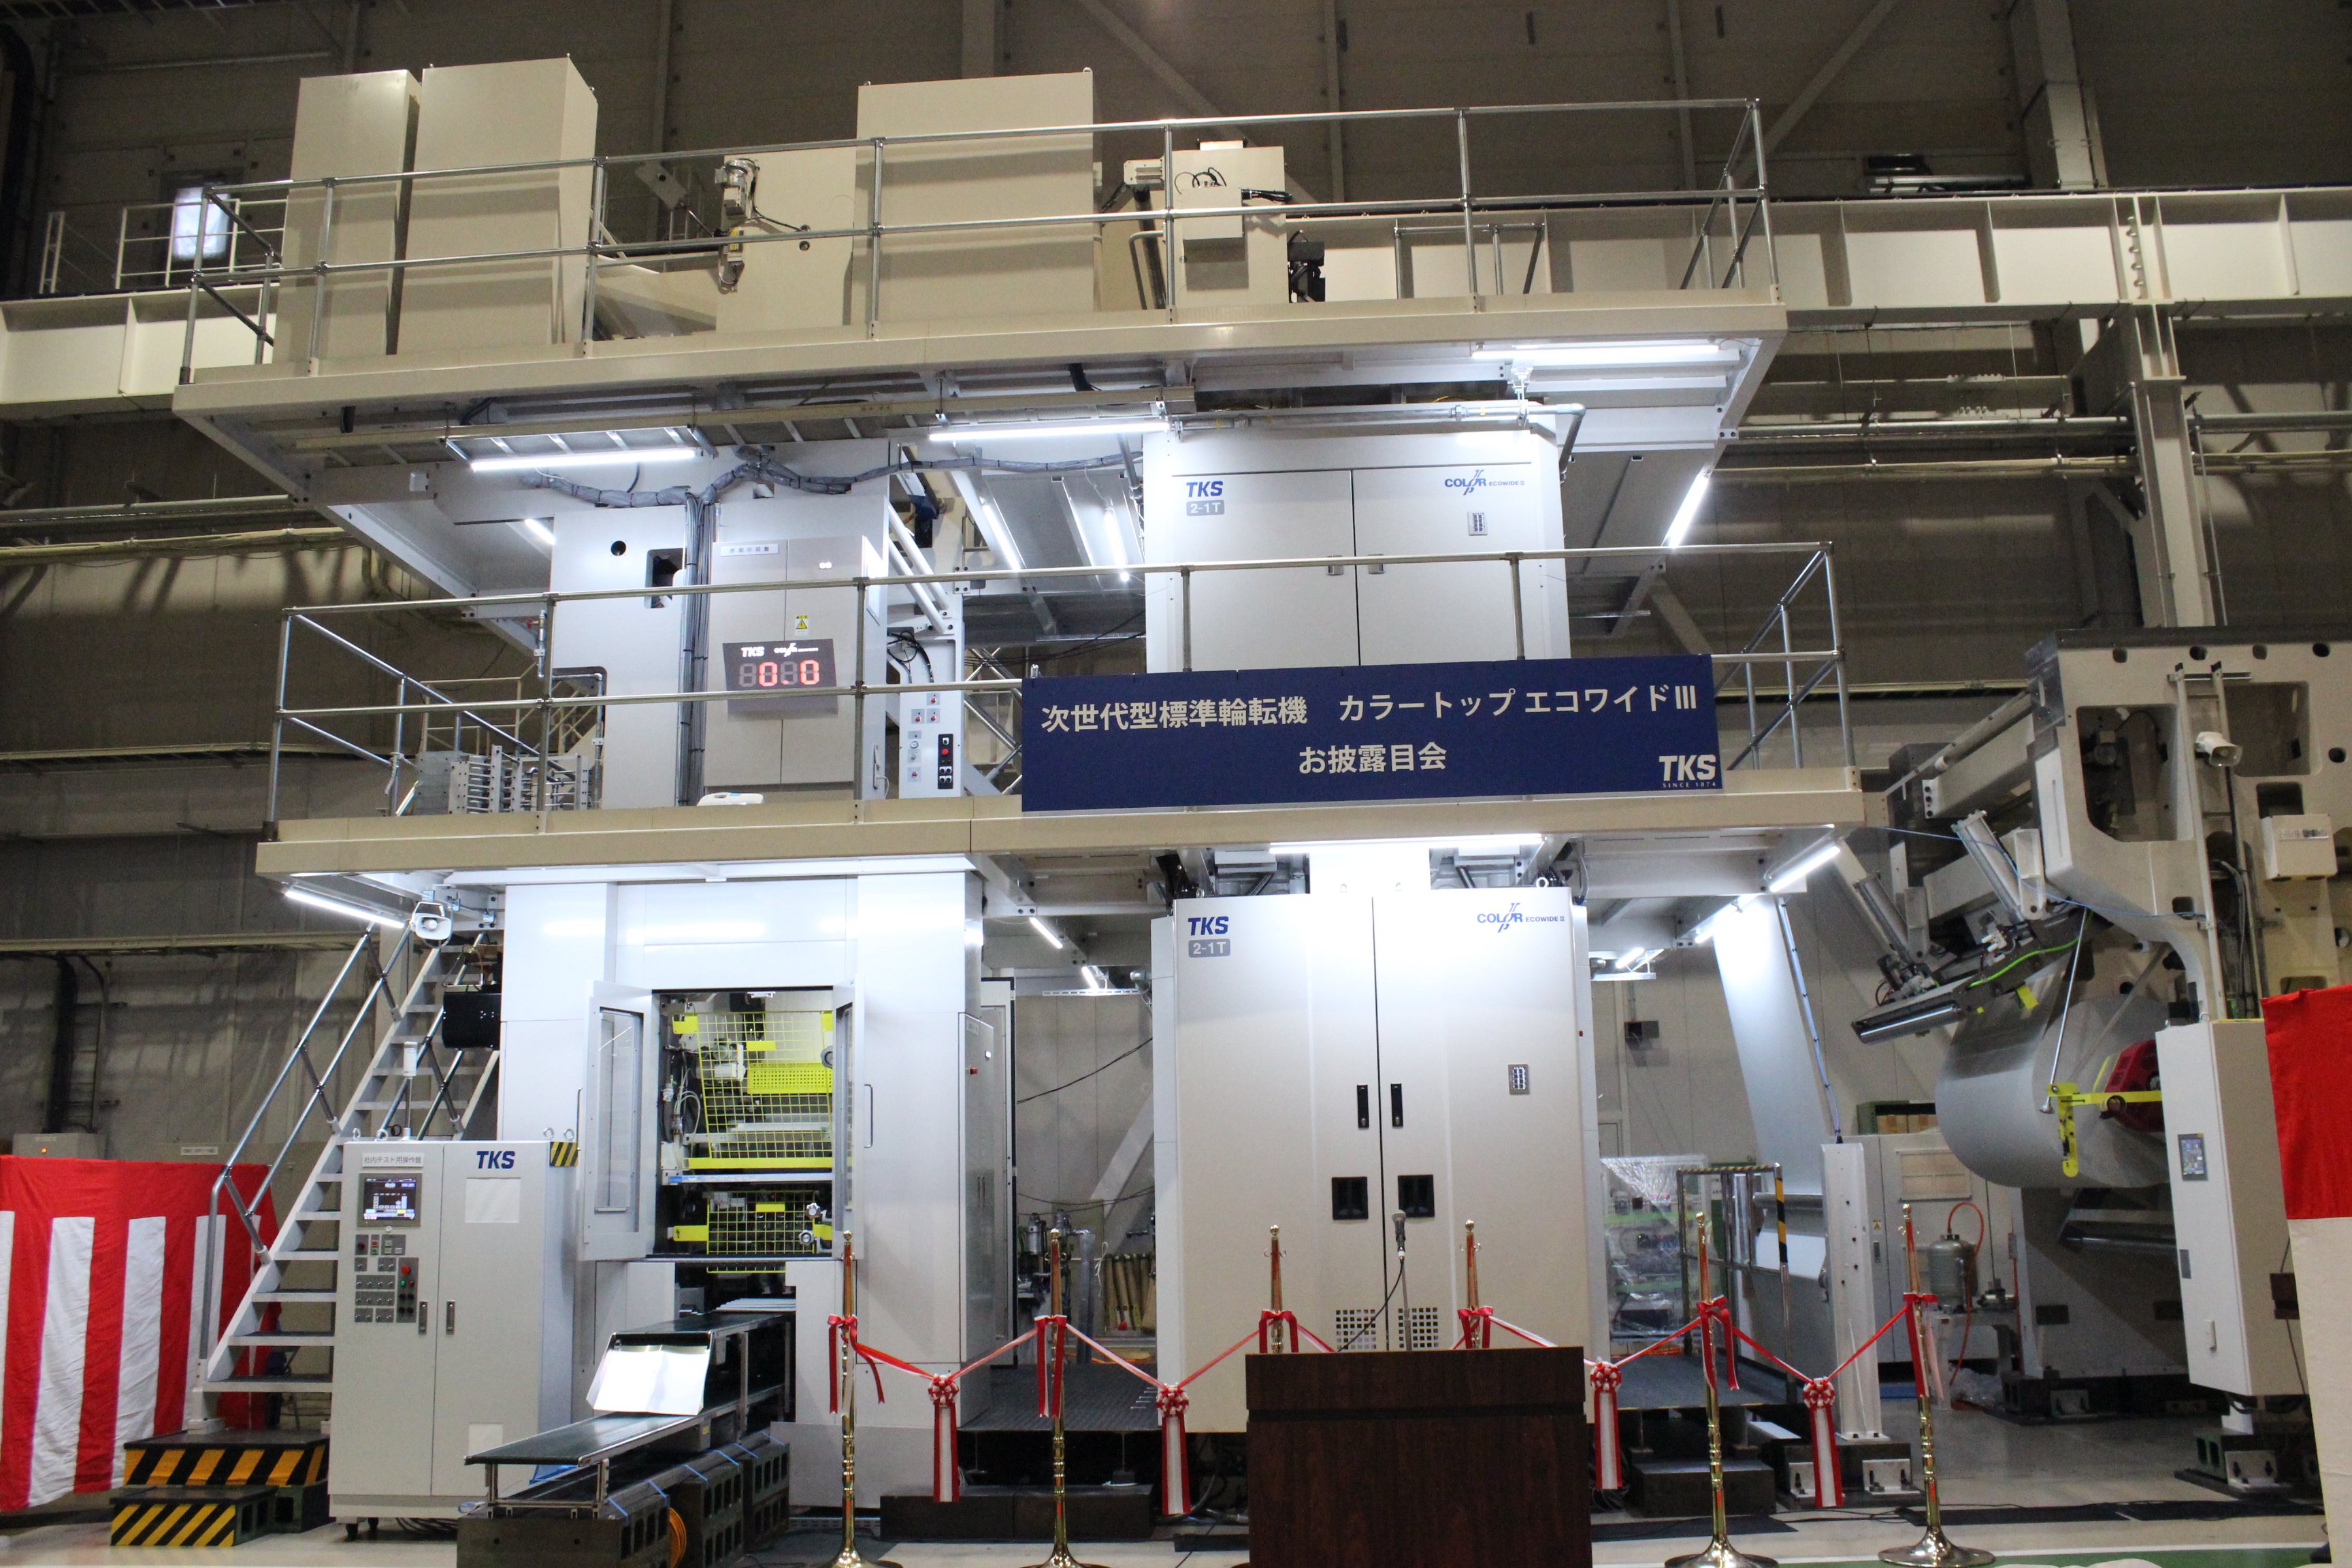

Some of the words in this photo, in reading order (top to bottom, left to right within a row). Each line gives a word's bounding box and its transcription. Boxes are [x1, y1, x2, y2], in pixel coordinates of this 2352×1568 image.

[1186, 480, 1223, 497] TKS
[1190, 502, 1221, 514] 2-1T
[741, 647, 764, 657] TKS
[1041, 696, 1309, 733] 次世代型標準輪転機
[1339, 688, 1516, 722] カラートップ
[1298, 741, 1448, 774] お披露目会
[1659, 754, 1716, 781] TKS
[1188, 916, 1229, 936] TKS
[1192, 941, 1226, 954] 2-1T
[476, 1150, 516, 1169] TKS
